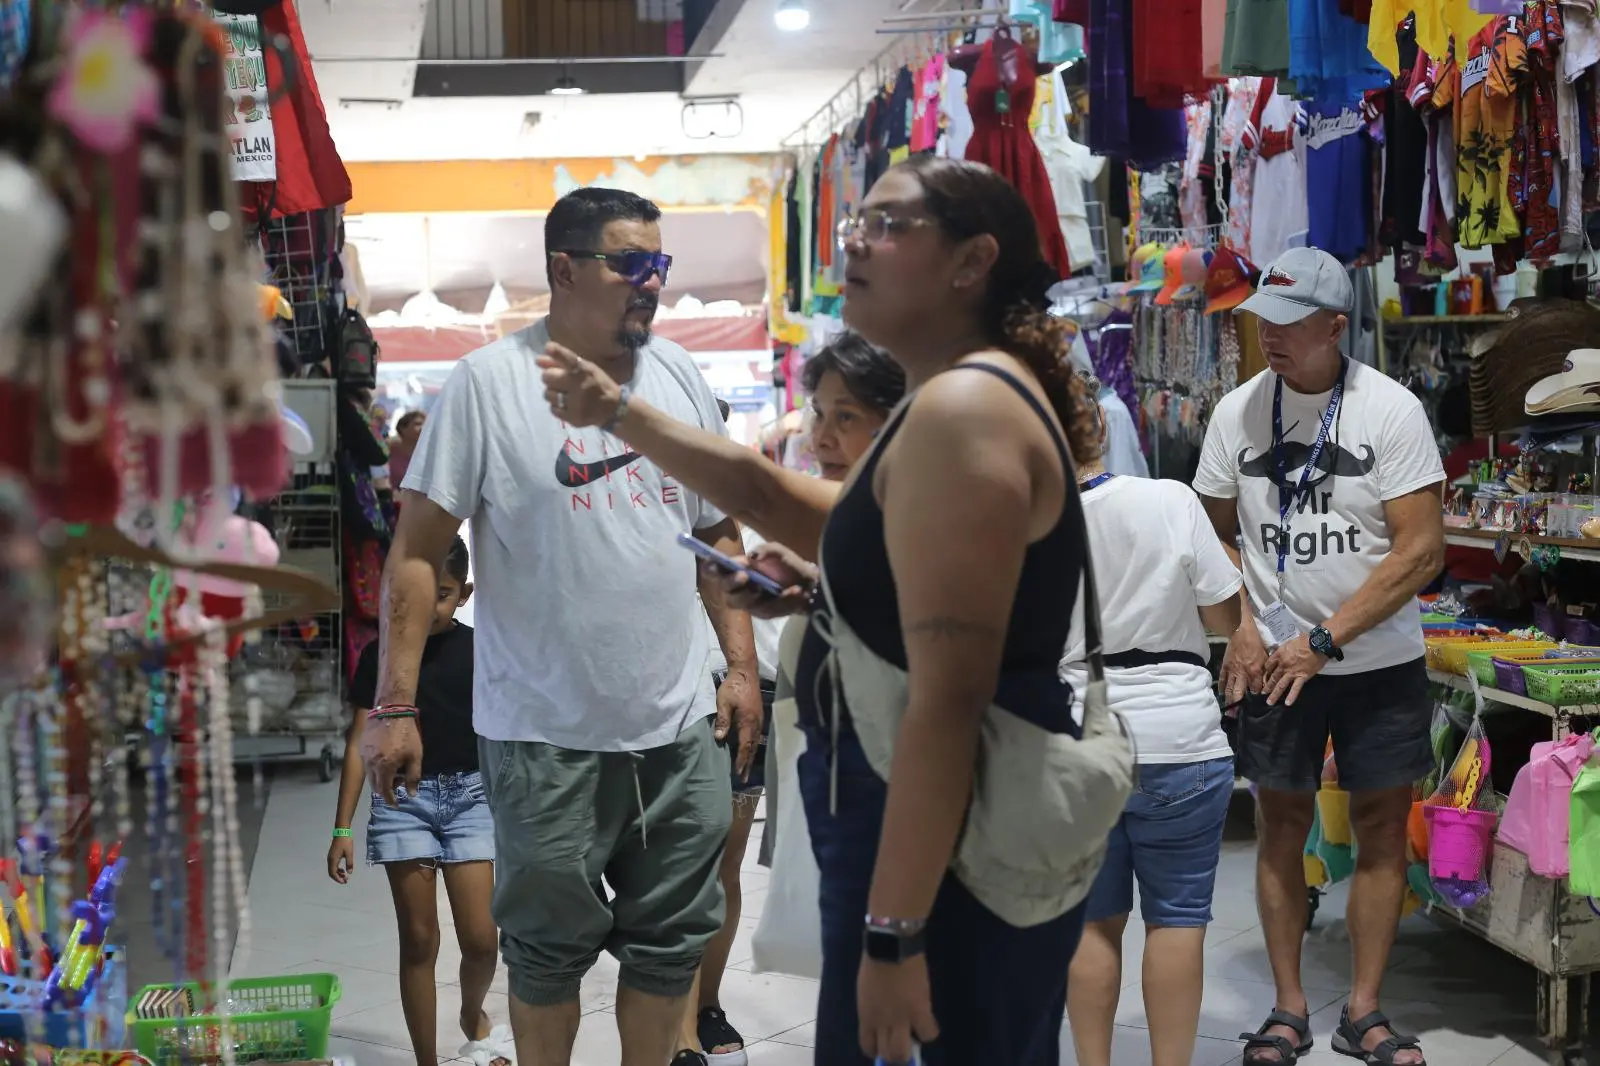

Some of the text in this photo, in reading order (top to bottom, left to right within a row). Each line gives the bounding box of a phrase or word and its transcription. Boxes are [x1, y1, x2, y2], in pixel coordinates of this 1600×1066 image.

[1507, 15, 1518, 33] 1
[231, 136, 271, 156] TLAN
[236, 154, 273, 163] MEXICO
[572, 486, 679, 511] NIKE
[1260, 522, 1361, 565] Right
